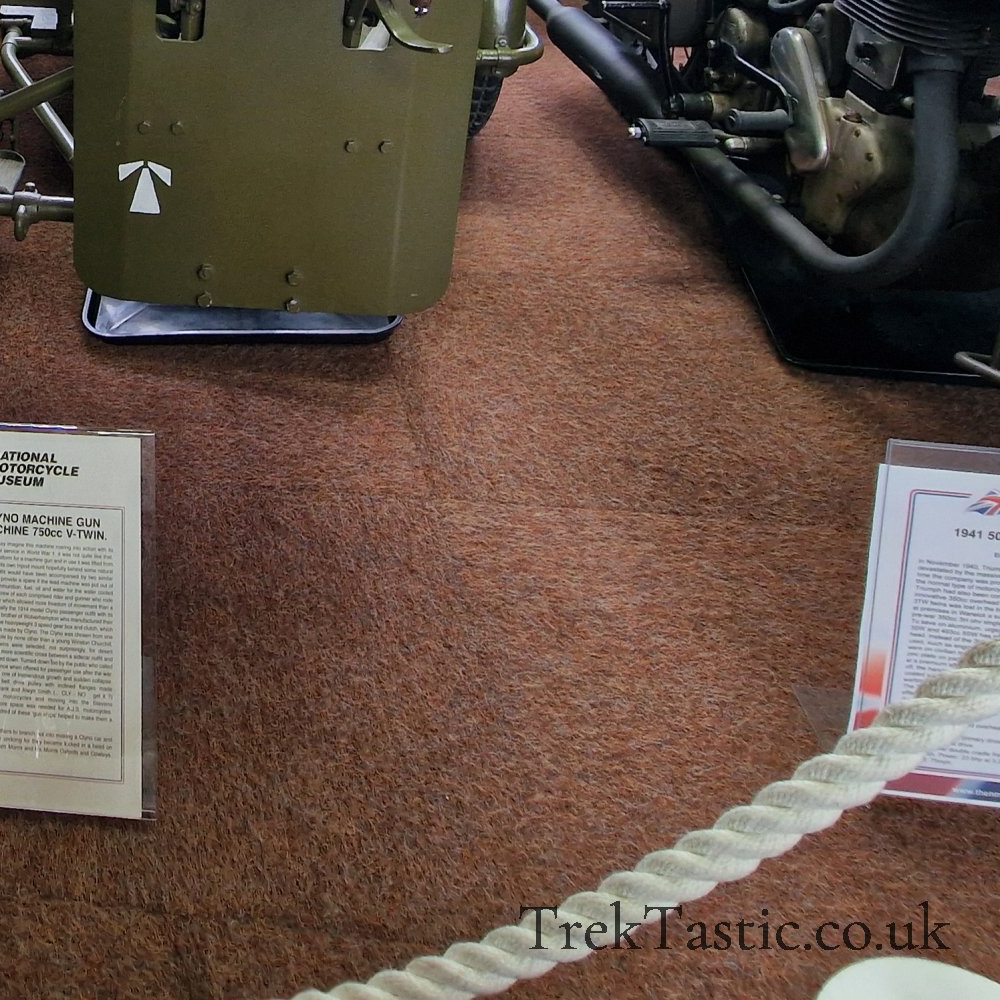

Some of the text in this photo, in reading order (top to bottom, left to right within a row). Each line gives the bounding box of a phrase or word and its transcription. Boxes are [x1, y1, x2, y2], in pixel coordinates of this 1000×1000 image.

[22, 514, 73, 527] MACHINE
[76, 516, 101, 528] GUN
[32, 526, 62, 538] 750cc
[66, 528, 108, 541] V-TWIN.
[954, 528, 982, 539] 1941
